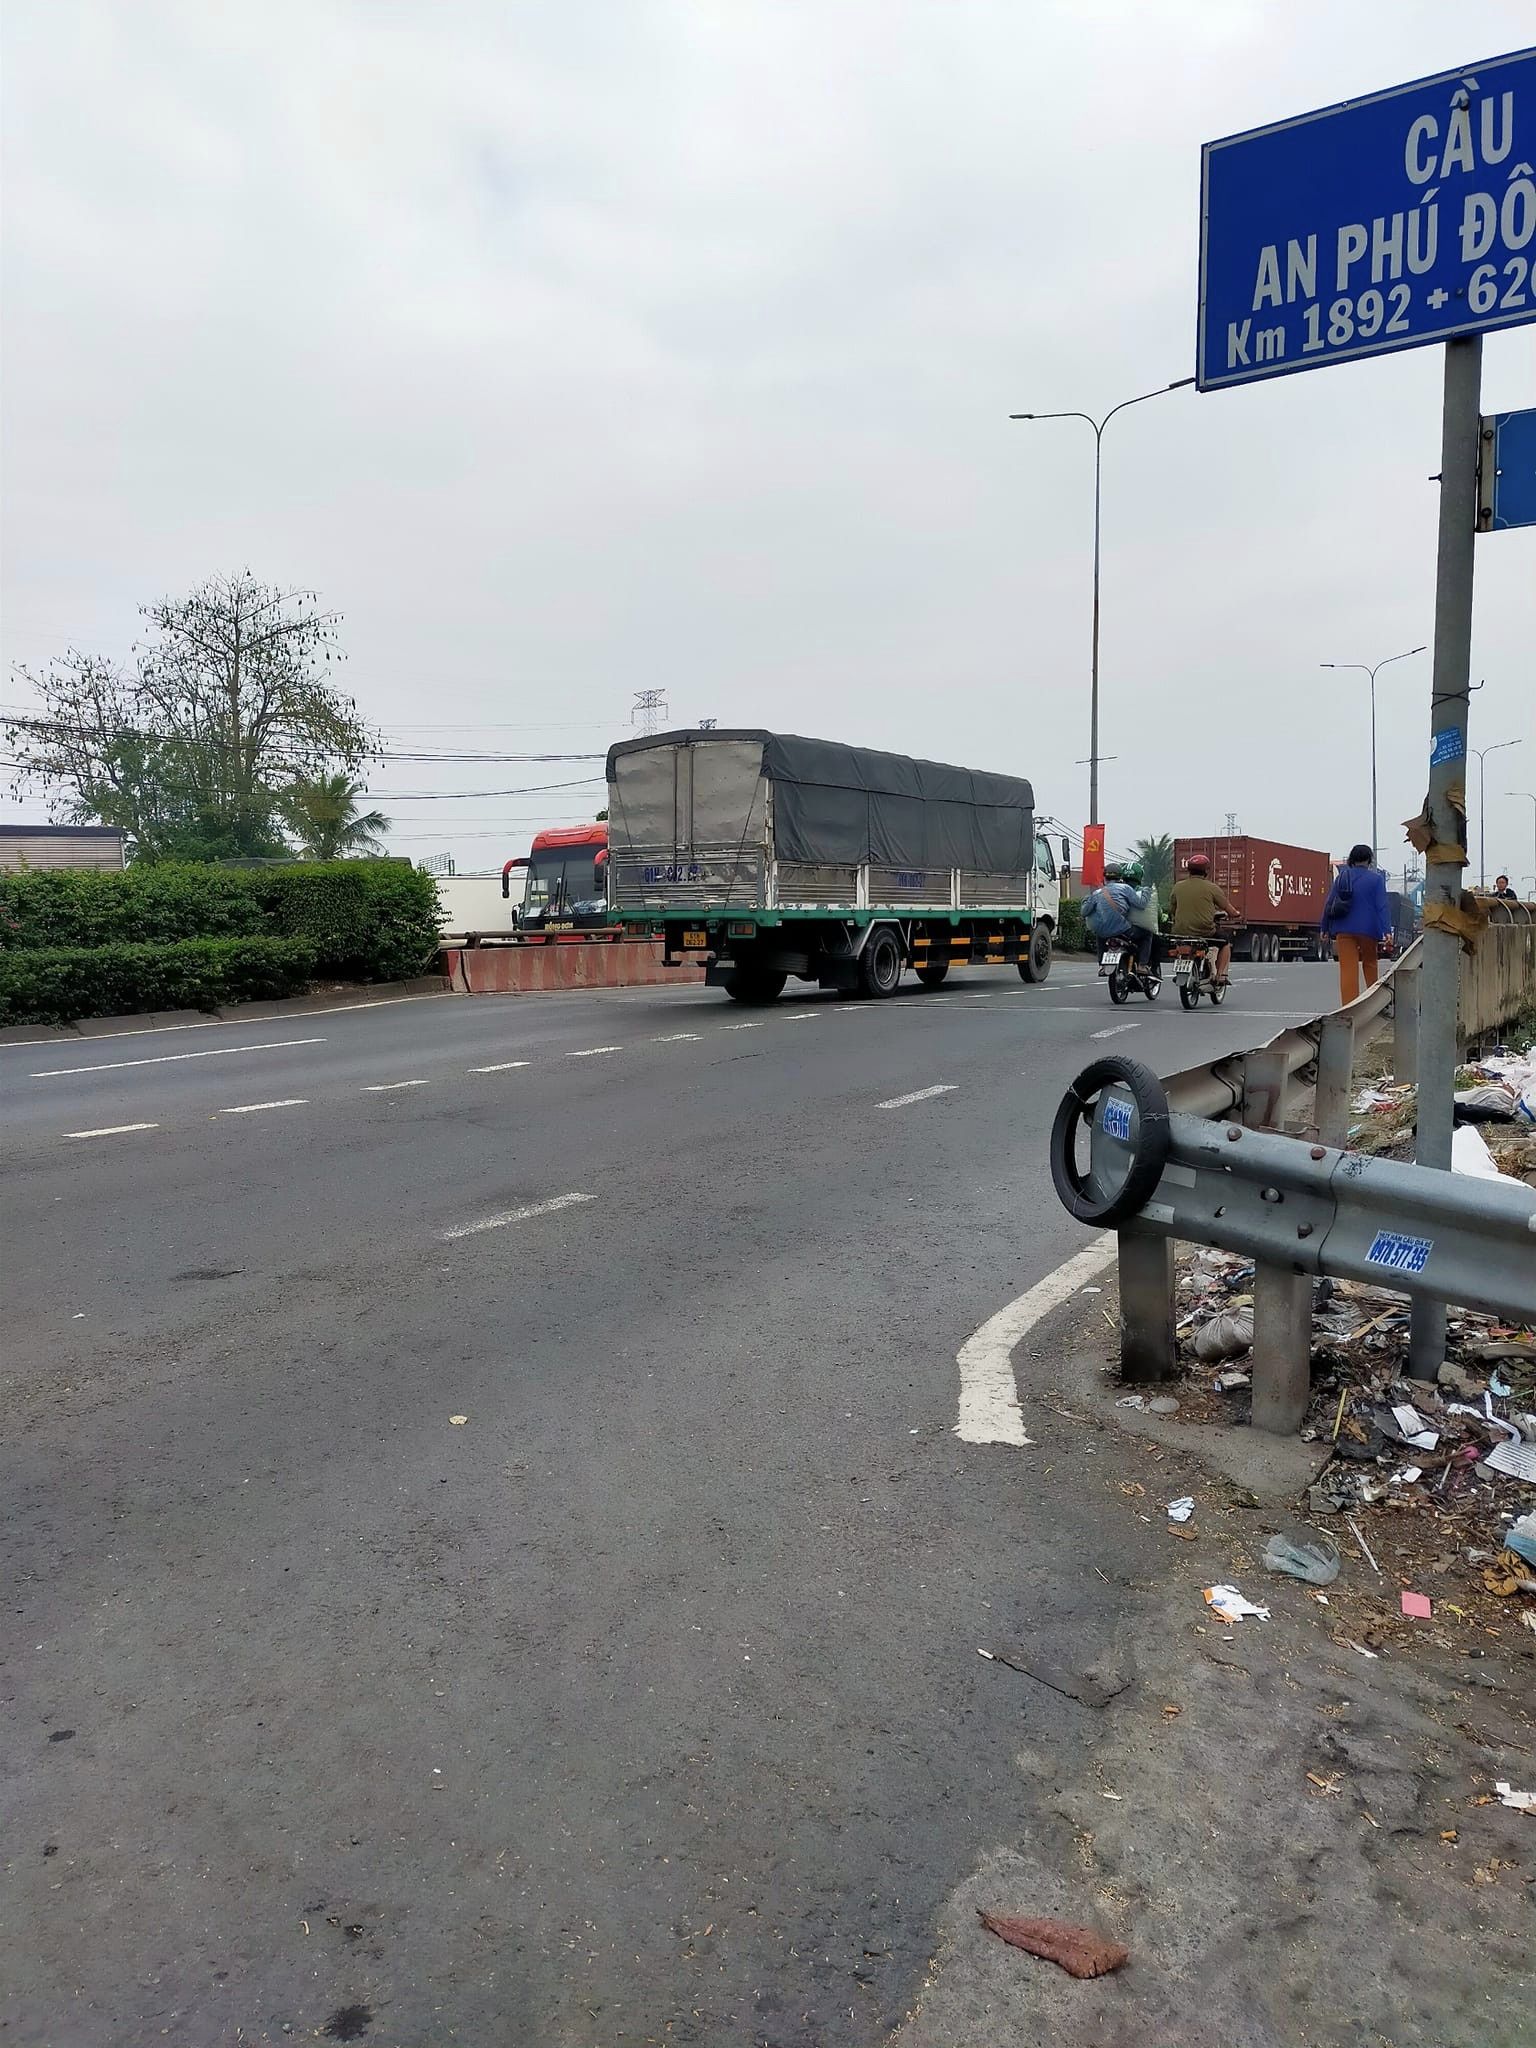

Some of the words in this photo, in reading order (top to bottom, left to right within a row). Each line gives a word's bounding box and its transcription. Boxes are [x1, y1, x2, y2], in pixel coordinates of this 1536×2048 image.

[1405, 77, 1514, 185] CẦU
[1252, 233, 1318, 312] AN
[1336, 187, 1441, 292] PHÚ
[1228, 318, 1286, 369] Km
[1302, 283, 1411, 353] 1892
[1426, 287, 1449, 311] +
[1468, 256, 1536, 314] 62
